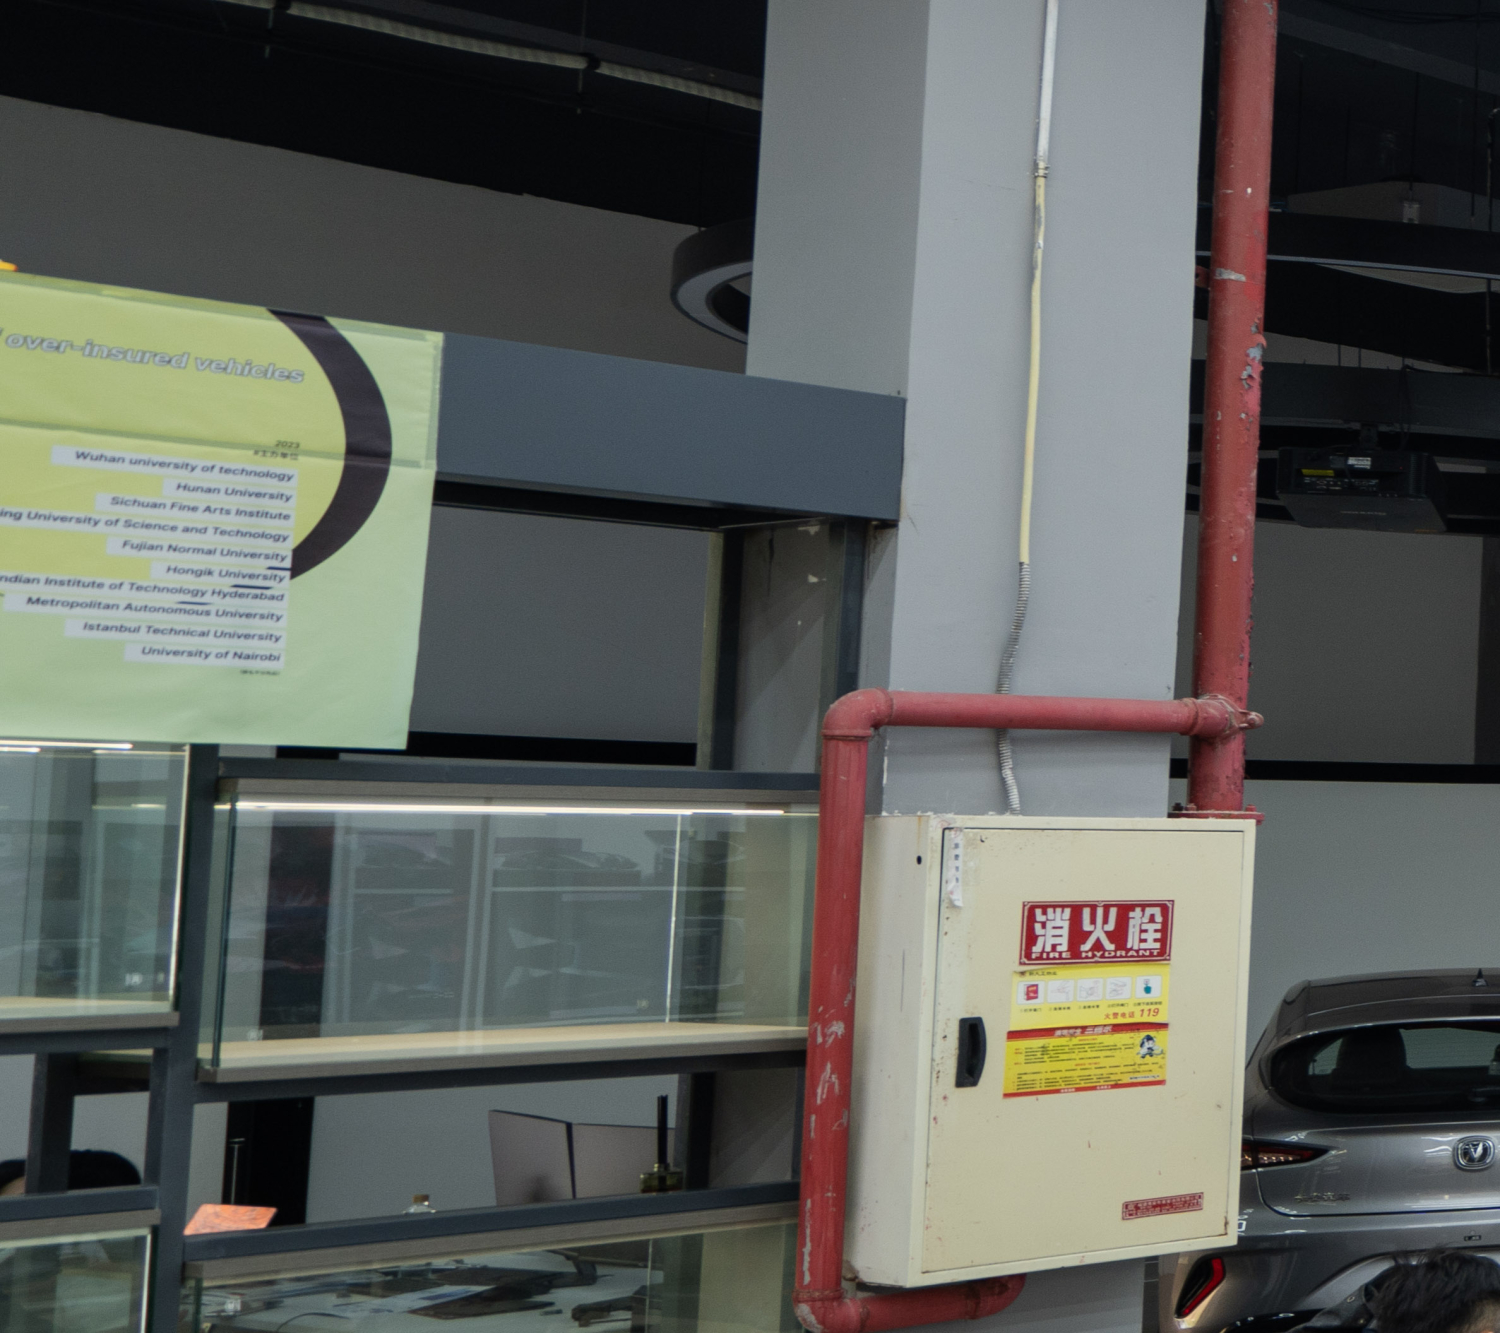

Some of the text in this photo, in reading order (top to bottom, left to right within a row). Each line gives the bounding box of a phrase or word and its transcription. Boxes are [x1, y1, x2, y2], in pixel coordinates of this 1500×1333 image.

[5, 333, 305, 383] over-insured vehicles
[275, 439, 300, 449] 2023
[75, 450, 294, 482] Wuhan university of technology
[176, 482, 293, 503] Hunan University
[110, 496, 291, 521] Sichuan Fine Arts Institute
[0, 508, 290, 543] ing University of Science and Technology
[122, 539, 288, 563] Fujian Normal University
[166, 565, 286, 584] Hongik University
[0, 574, 285, 602] ndian Institute of Technology Hyderabad
[26, 596, 284, 623] Metropolitan Autonomous University
[83, 622, 282, 643] Istanbul Technical University
[141, 646, 281, 662] University of Nairobi
[1032, 907, 1164, 952] 消火栓
[1031, 950, 1160, 959] FIRE HYDRANT
[1139, 1007, 1160, 1018] 119
